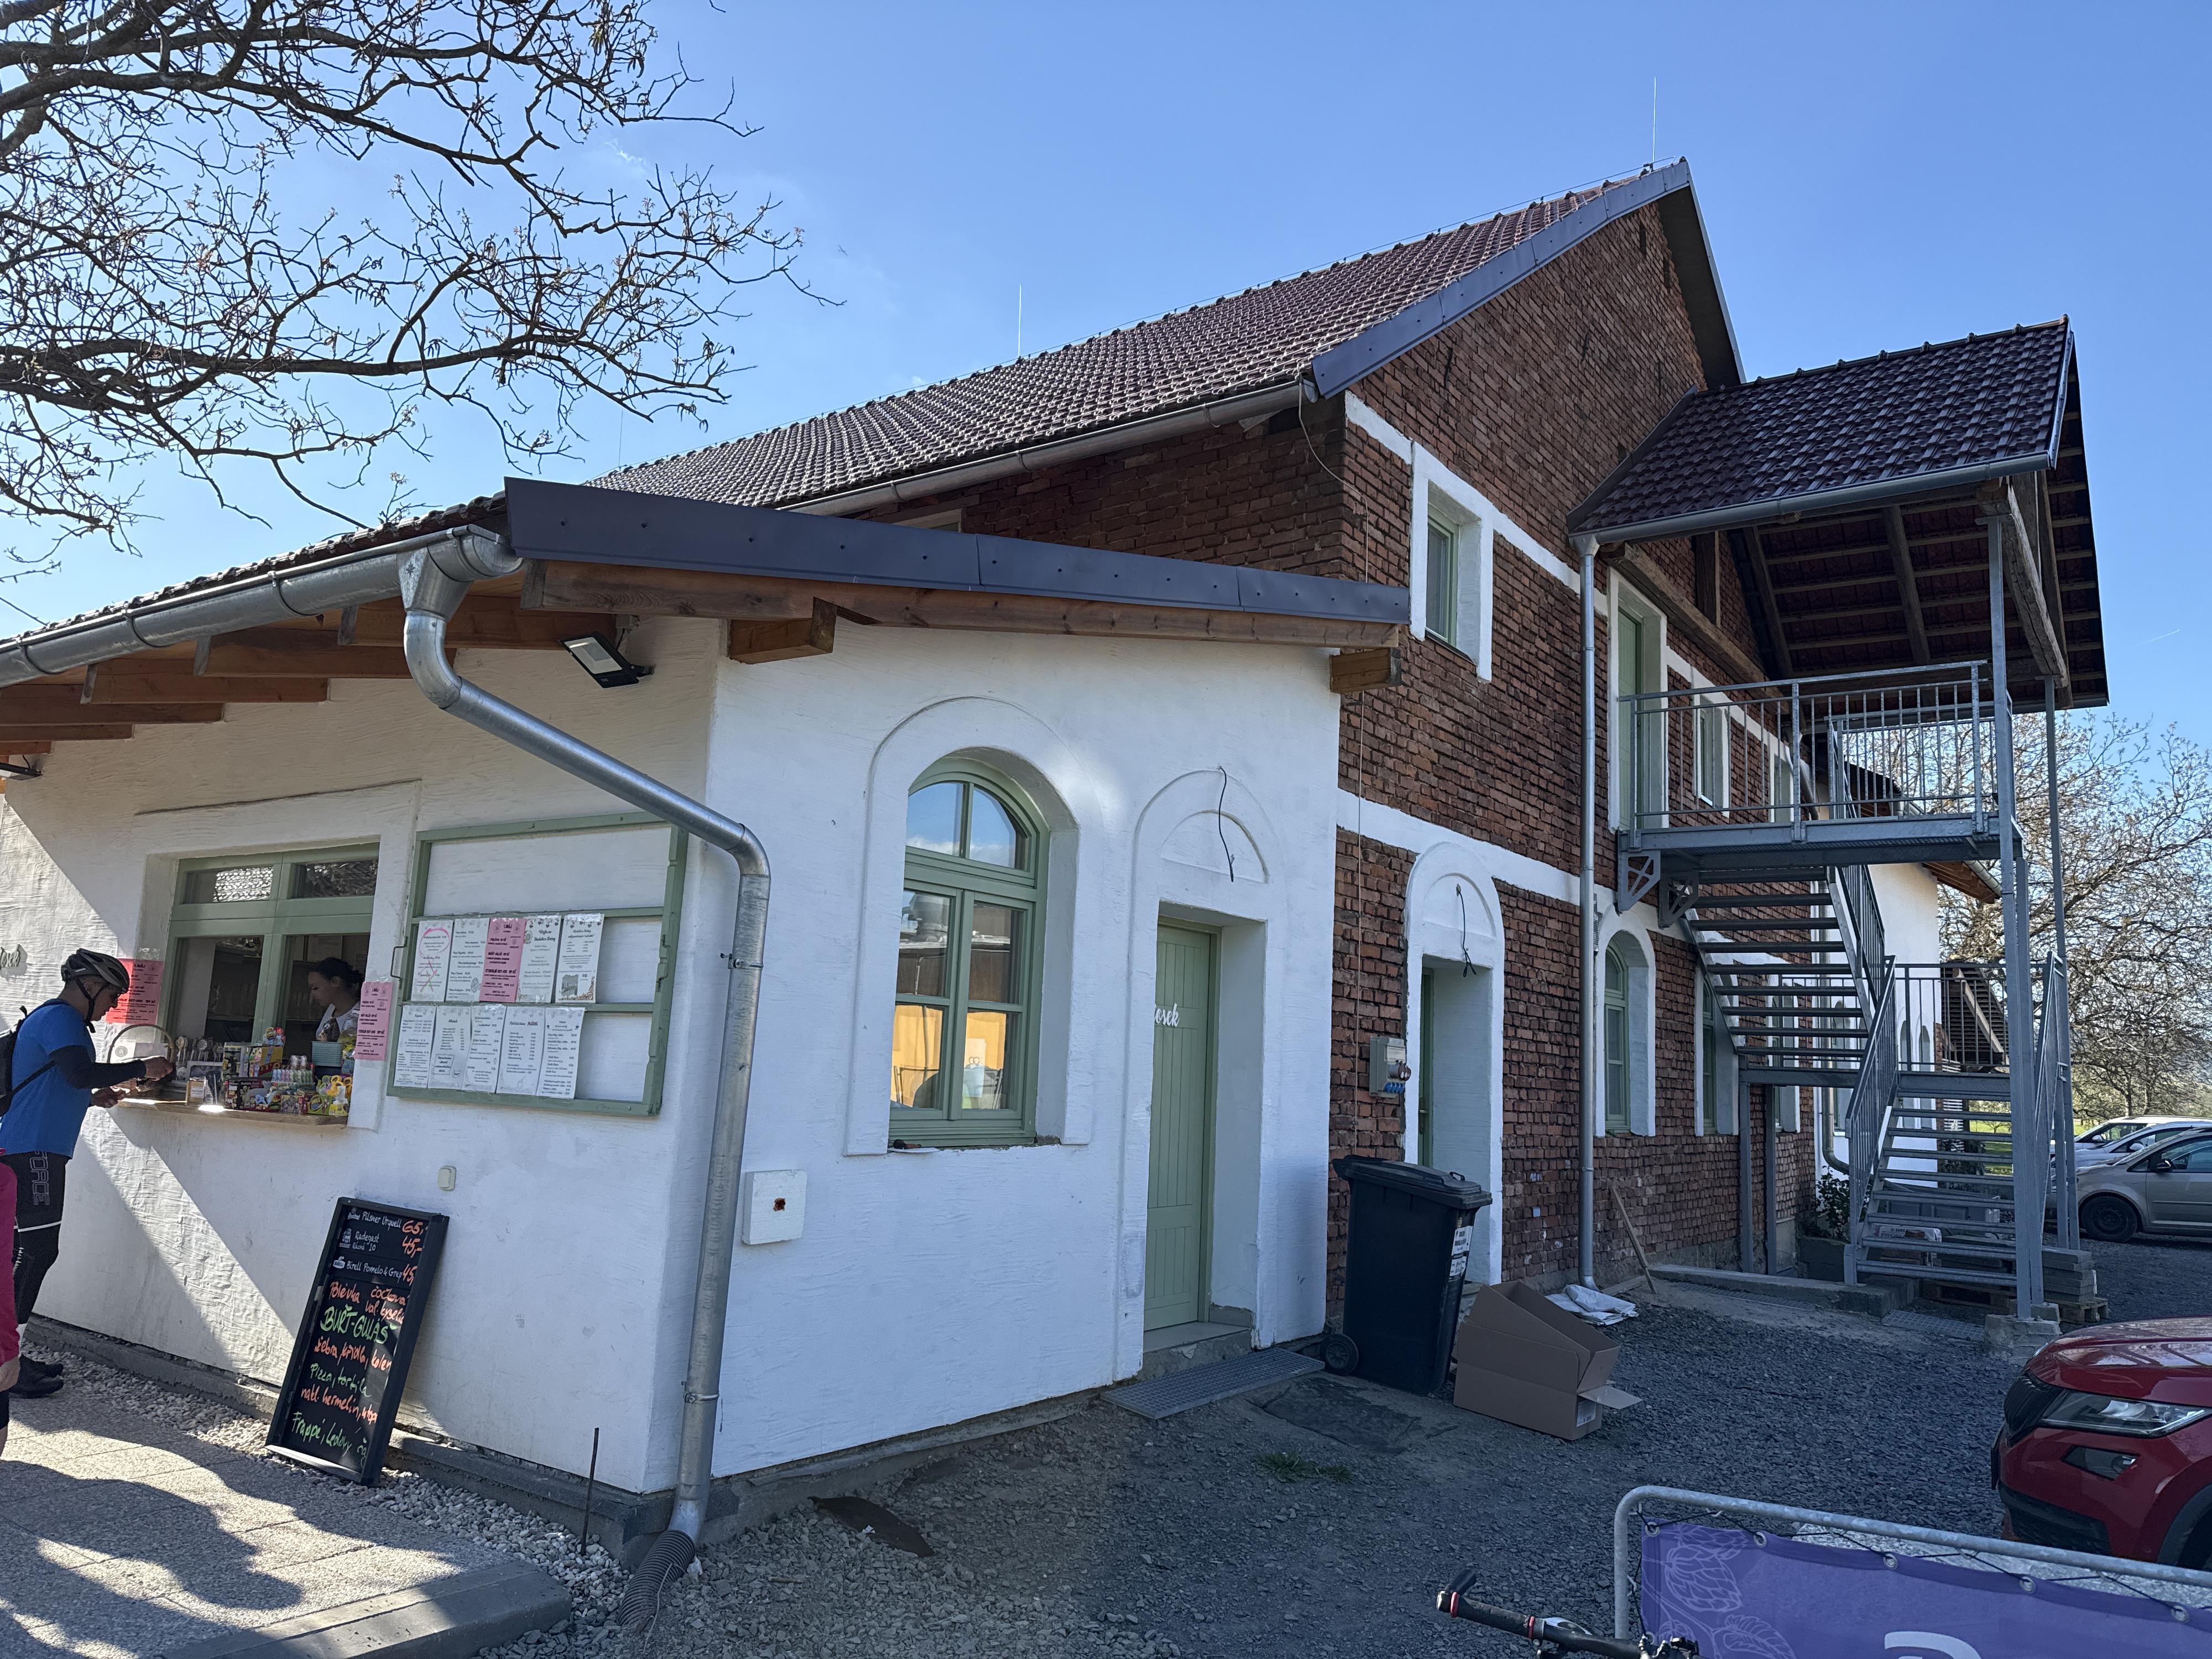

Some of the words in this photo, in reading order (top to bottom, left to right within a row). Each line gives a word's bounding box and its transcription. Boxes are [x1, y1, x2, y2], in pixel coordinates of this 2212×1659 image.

[1154, 1003, 1180, 1027] osek
[362, 1211, 381, 1224] Pilsner
[382, 1215, 402, 1231] Urquell
[354, 1231, 380, 1245] Radegast
[346, 1261, 361, 1271] Birell
[363, 1263, 383, 1275] Pomelo
[388, 1267, 403, 1284] Grep
